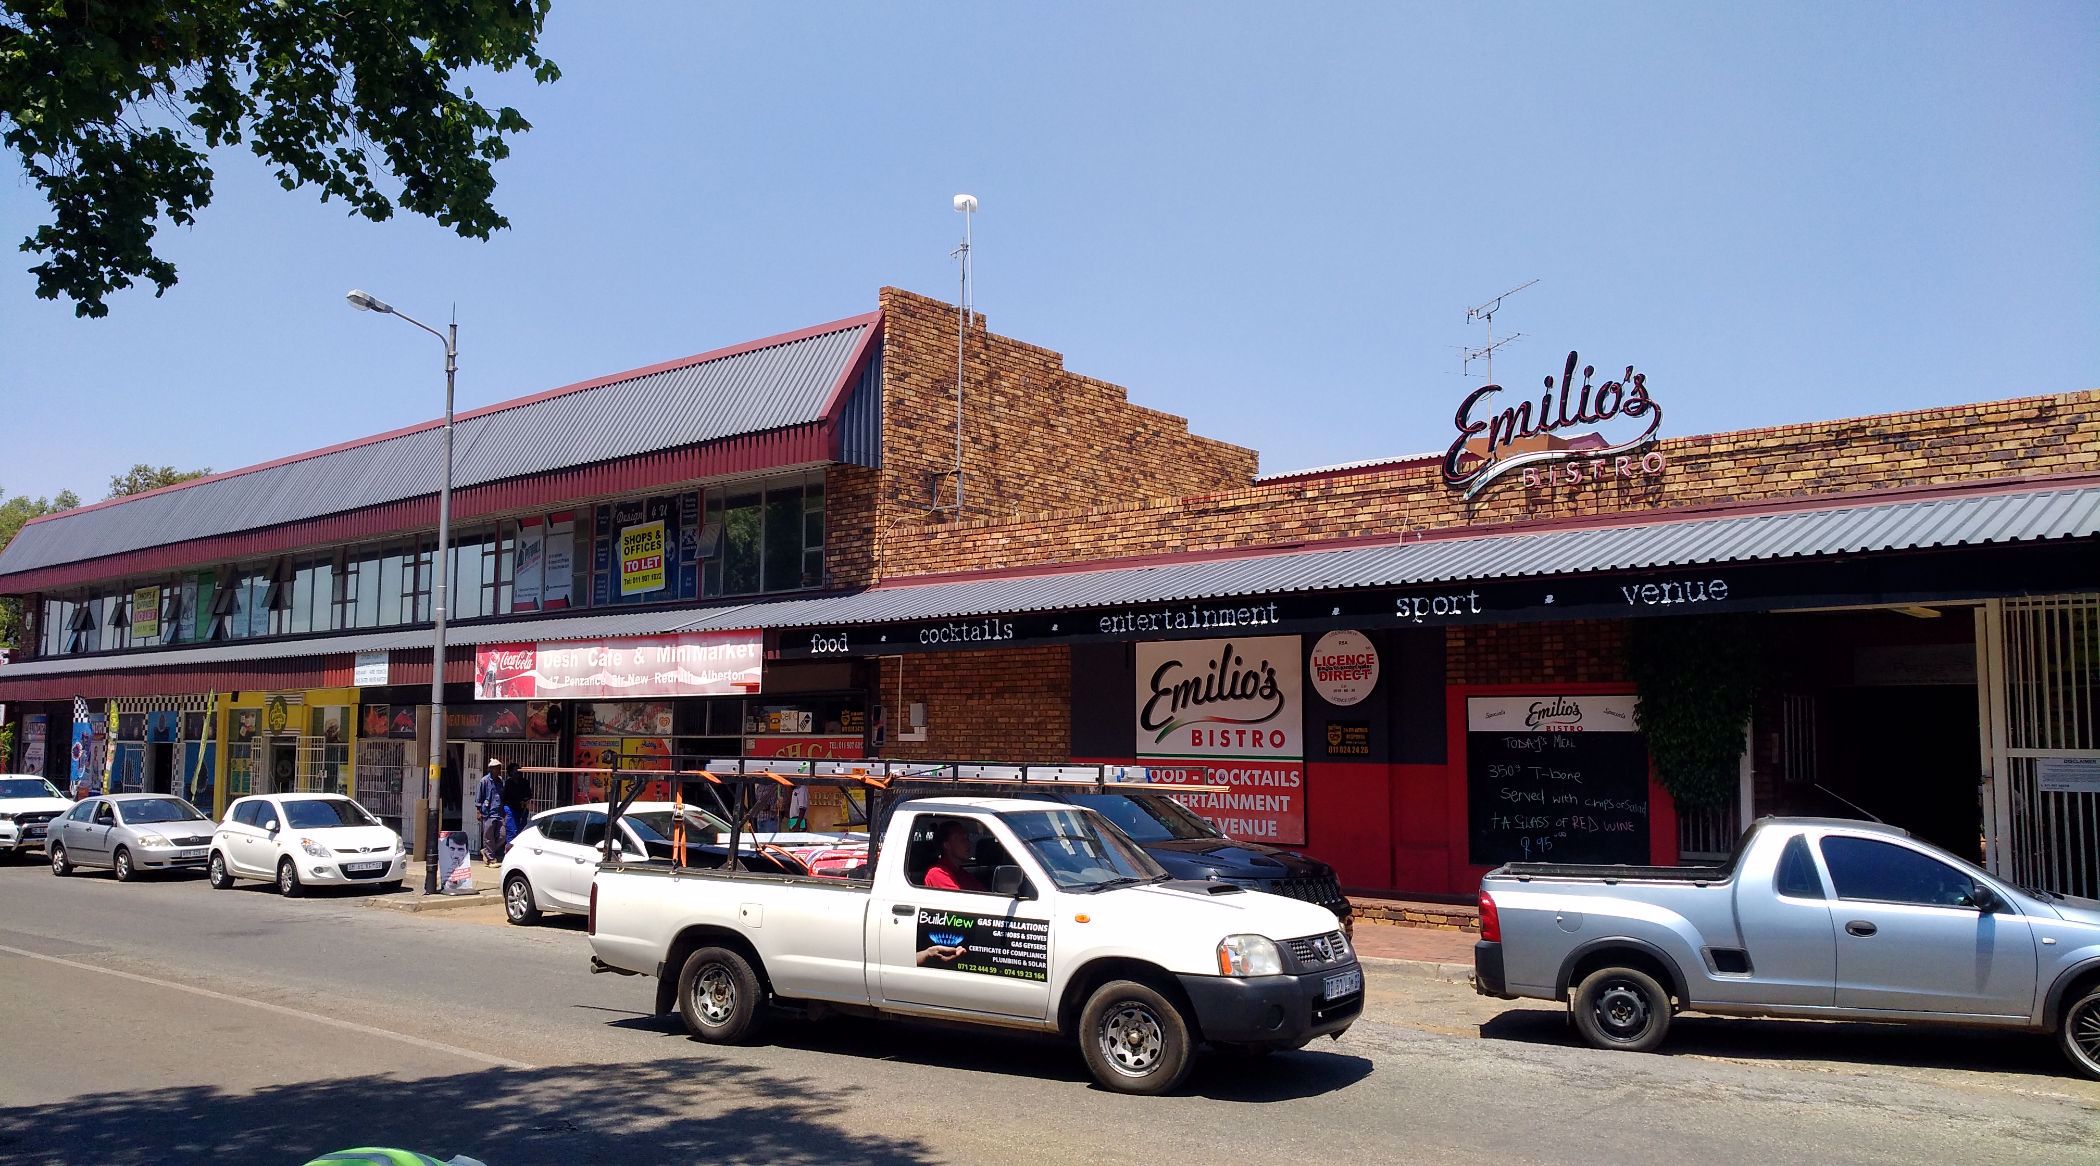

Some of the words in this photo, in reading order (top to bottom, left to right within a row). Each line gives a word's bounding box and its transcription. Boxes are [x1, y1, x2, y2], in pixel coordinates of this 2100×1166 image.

[1443, 351, 1662, 484] Emilio's
[1522, 452, 1667, 488] BISTRO
[624, 531, 653, 546] SHOPS
[655, 529, 661, 539] &
[624, 540, 662, 556] OFFICES
[626, 561, 638, 572] TO
[641, 556, 660, 570] LET
[810, 633, 849, 654] food
[919, 619, 1013, 644] cocktails
[1100, 602, 1280, 633] entertainment
[1396, 590, 1482, 623] sport
[1620, 579, 1728, 607] venue
[543, 653, 578, 668] Desh
[588, 648, 622, 667] Cafe
[633, 648, 645, 664] &
[1314, 653, 1375, 668] LICENCE
[564, 675, 606, 686] Penzance
[700, 669, 744, 681] Alberton
[1319, 669, 1372, 682] DIRECT
[1140, 643, 1286, 732] Emilio's
[1524, 696, 1583, 726] Emilio's
[1191, 730, 1286, 748] BISTRO
[1150, 769, 1187, 783] OOD
[1208, 768, 1300, 788] COCKTAILS
[1171, 793, 1291, 812] ERTAINMENT
[1500, 788, 1545, 806] Served
[1552, 793, 1578, 804] with
[1218, 817, 1277, 837] VENUE
[1572, 816, 1600, 832] RED
[920, 912, 974, 928] BuildView
[977, 918, 992, 926] GAS
[993, 920, 1048, 932] INSTALLATIONS
[1026, 934, 1047, 942] STOVES
[968, 945, 1002, 954] CERTIFICATE
[1010, 950, 1047, 960] COMPLIANCE
[992, 957, 1022, 966] PLUMBING
